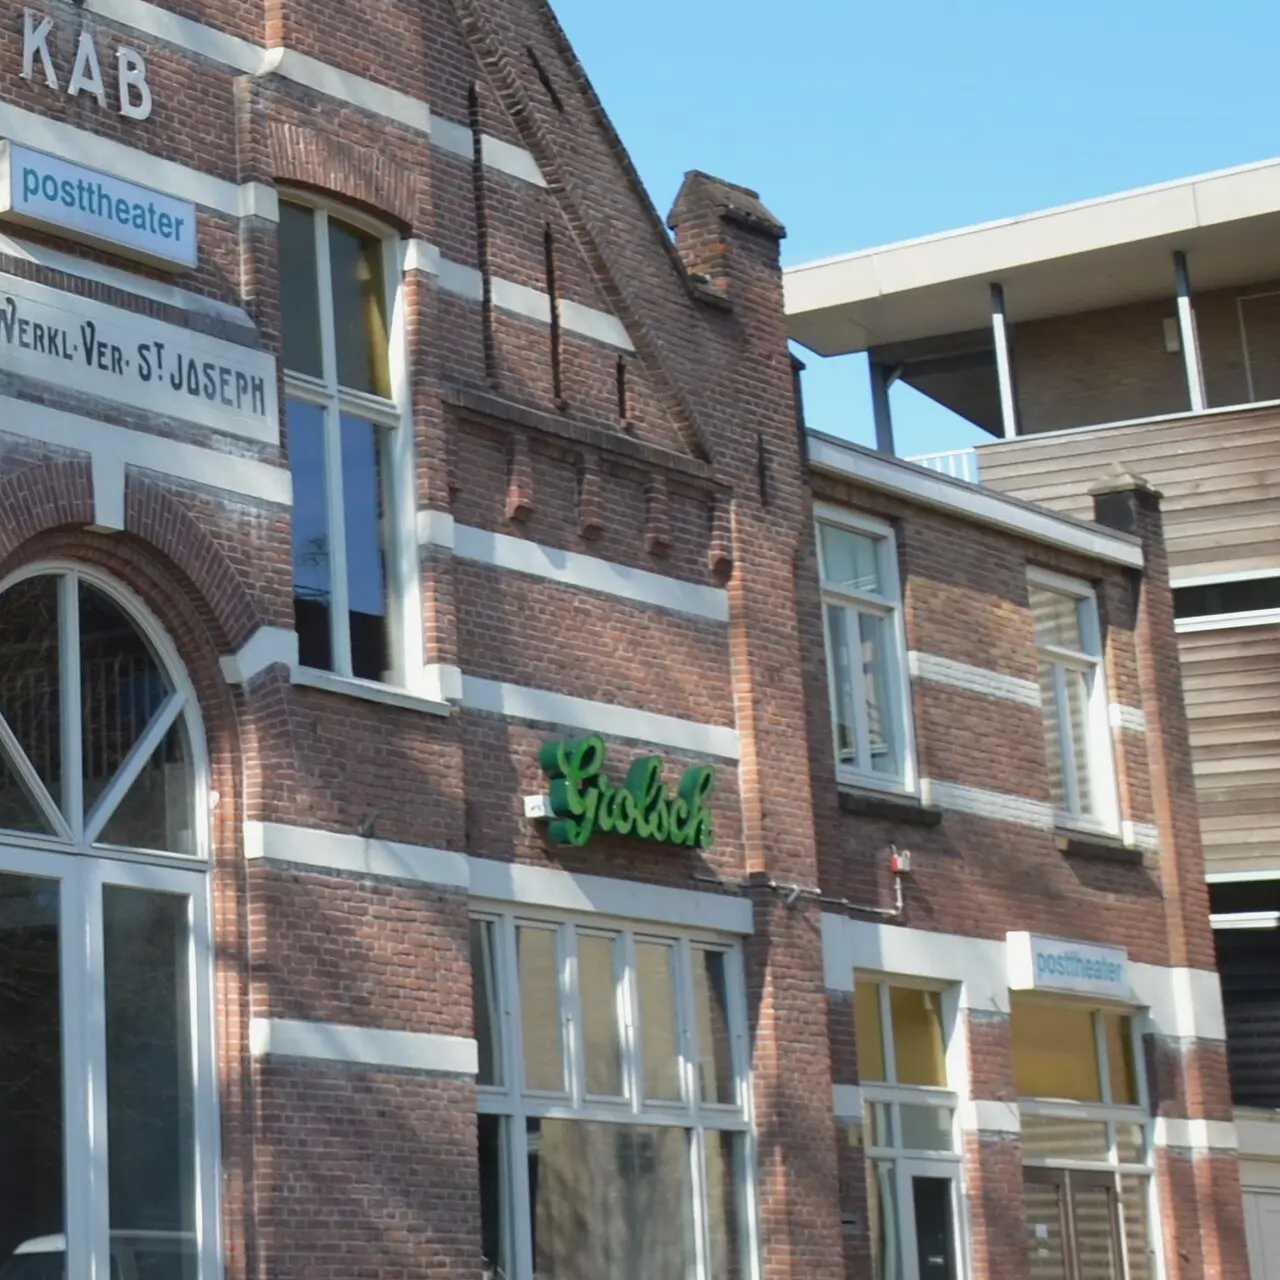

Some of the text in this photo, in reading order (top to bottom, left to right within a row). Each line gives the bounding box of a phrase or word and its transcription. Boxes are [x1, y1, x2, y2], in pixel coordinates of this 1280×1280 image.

[19, 6, 153, 120] KAB
[22, 166, 185, 241] posttheater
[170, 353, 266, 417] JOSEPH
[544, 733, 715, 850] Grolsch
[1036, 951, 1124, 982] posttheater
